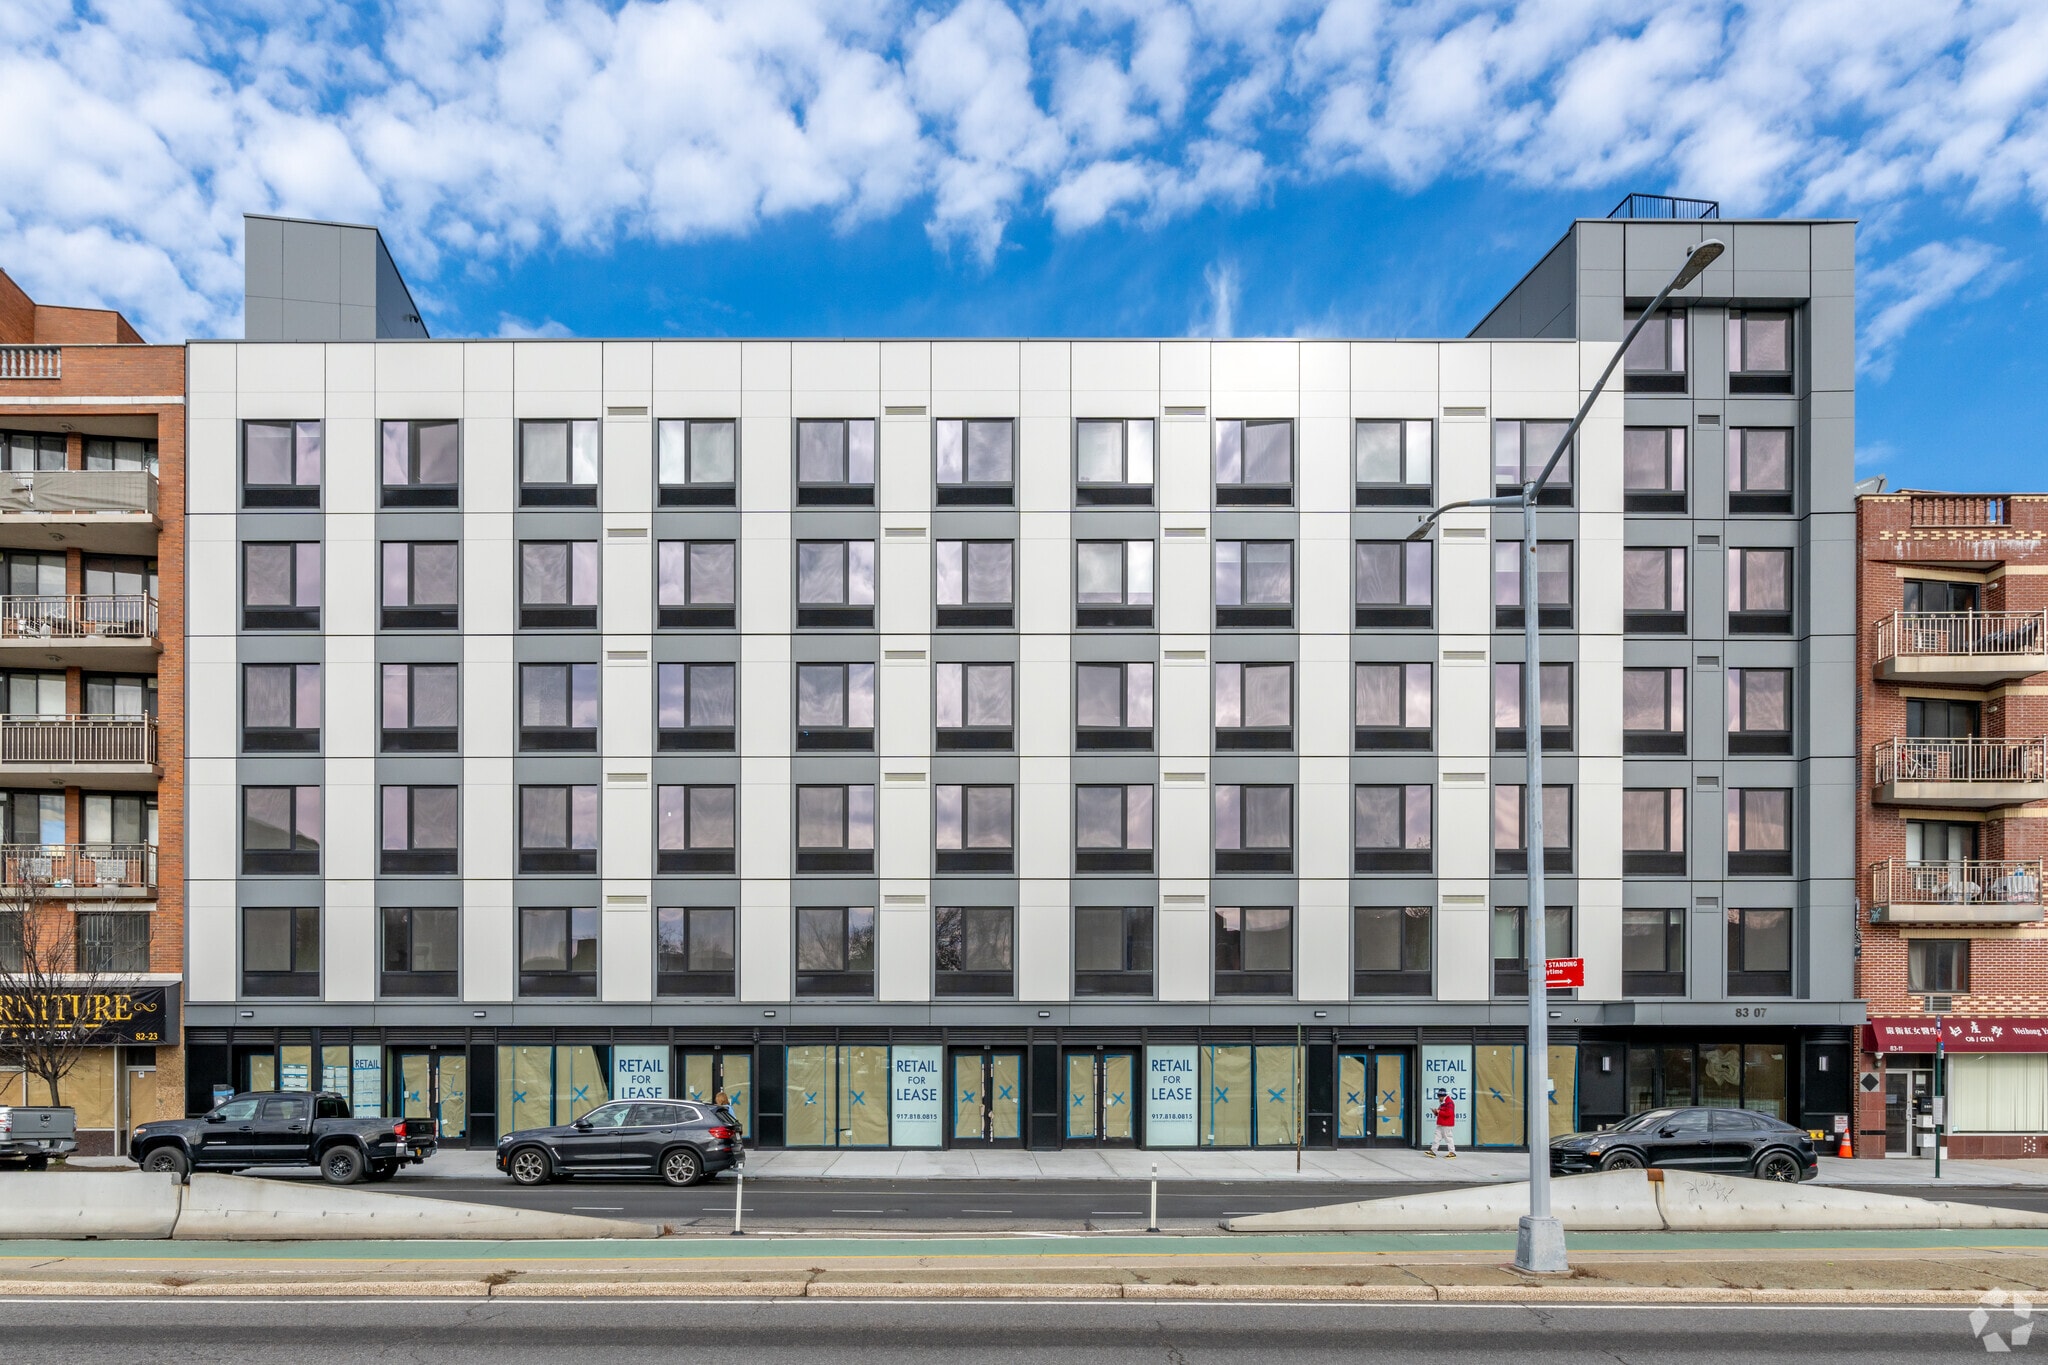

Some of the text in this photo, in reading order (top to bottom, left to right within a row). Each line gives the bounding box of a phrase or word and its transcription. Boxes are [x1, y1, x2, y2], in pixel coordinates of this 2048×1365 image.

[1735, 1008, 1767, 1018] 83 07
[135, 1032, 158, 1040] 82-23
[355, 1060, 380, 1068] RETAIL
[619, 1059, 664, 1072] RETAIL
[896, 1060, 938, 1073] RETAIL
[1152, 1059, 1192, 1072] RETAIL
[1426, 1059, 1467, 1072] RETAIL
[631, 1075, 651, 1084] FOR
[908, 1076, 926, 1085] FOR
[1163, 1075, 1181, 1084] FOR
[1437, 1075, 1455, 1084] FOR
[622, 1087, 662, 1099] LEASE
[896, 1088, 937, 1101] LEASE
[1152, 1088, 1192, 1100] LEASE
[1426, 1088, 1466, 1100] LESE
